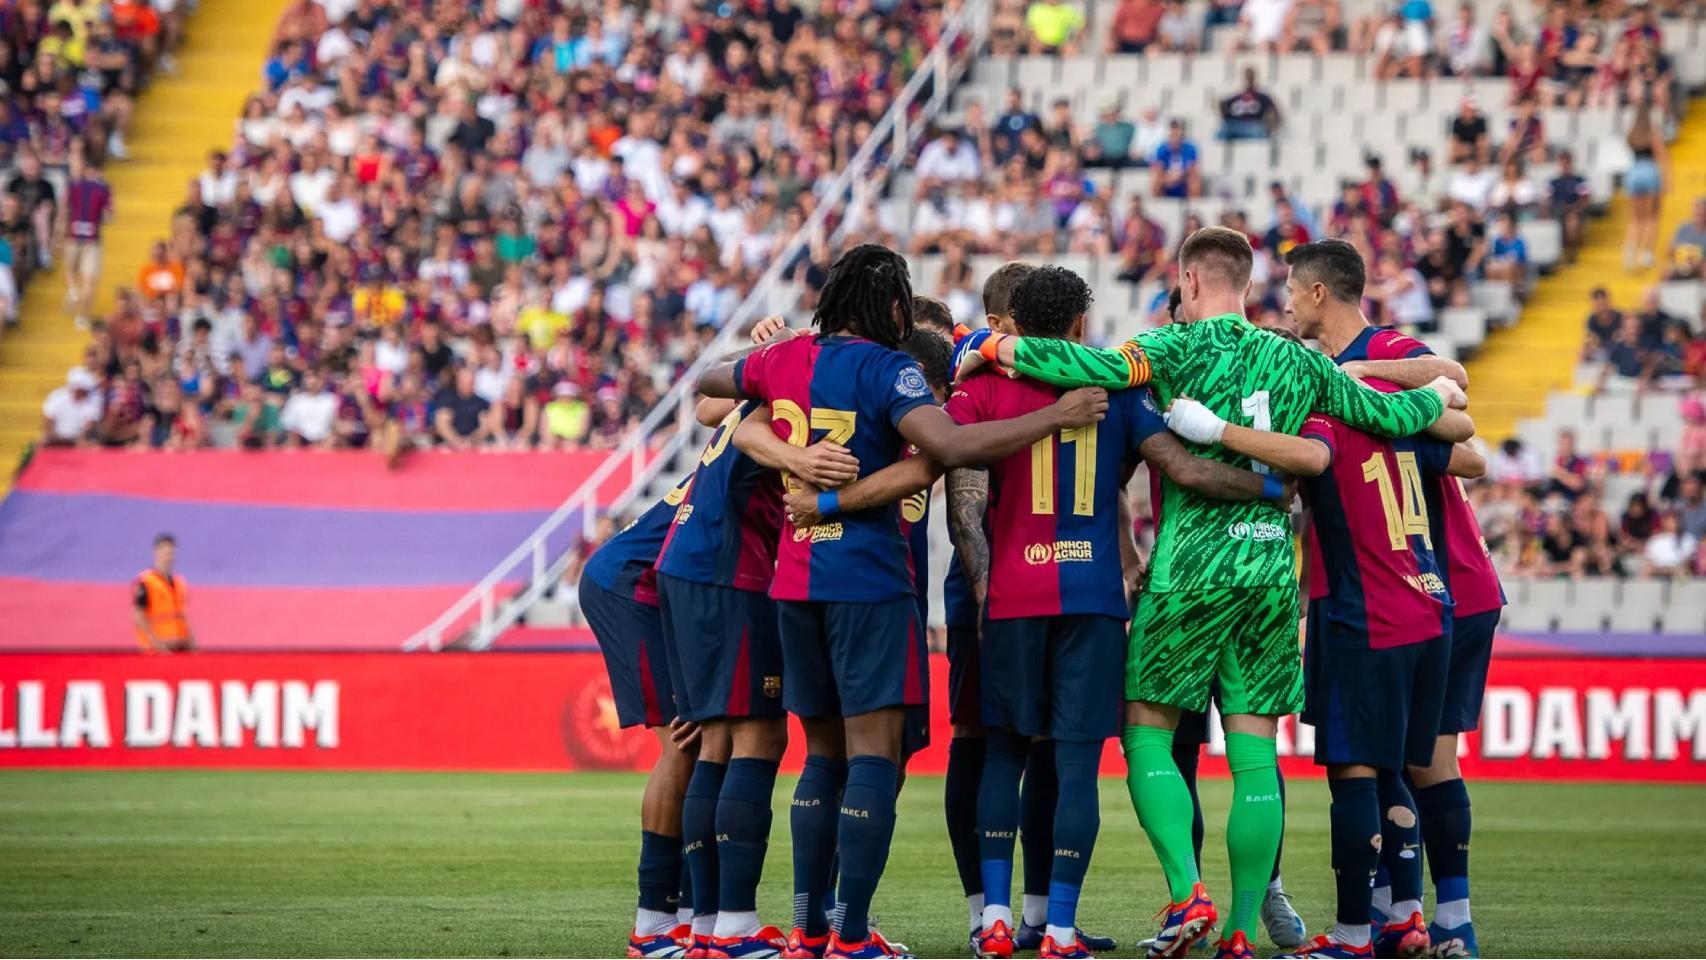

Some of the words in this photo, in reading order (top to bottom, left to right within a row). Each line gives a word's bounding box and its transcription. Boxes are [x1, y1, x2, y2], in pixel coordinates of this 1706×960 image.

[1032, 421, 1098, 516] 11
[1361, 452, 1433, 550] 14
[1053, 540, 1092, 550] UNHCR
[1054, 550, 1092, 559] ACNUR
[124, 680, 340, 748] DAMM
[1482, 686, 1706, 760] DAMM
